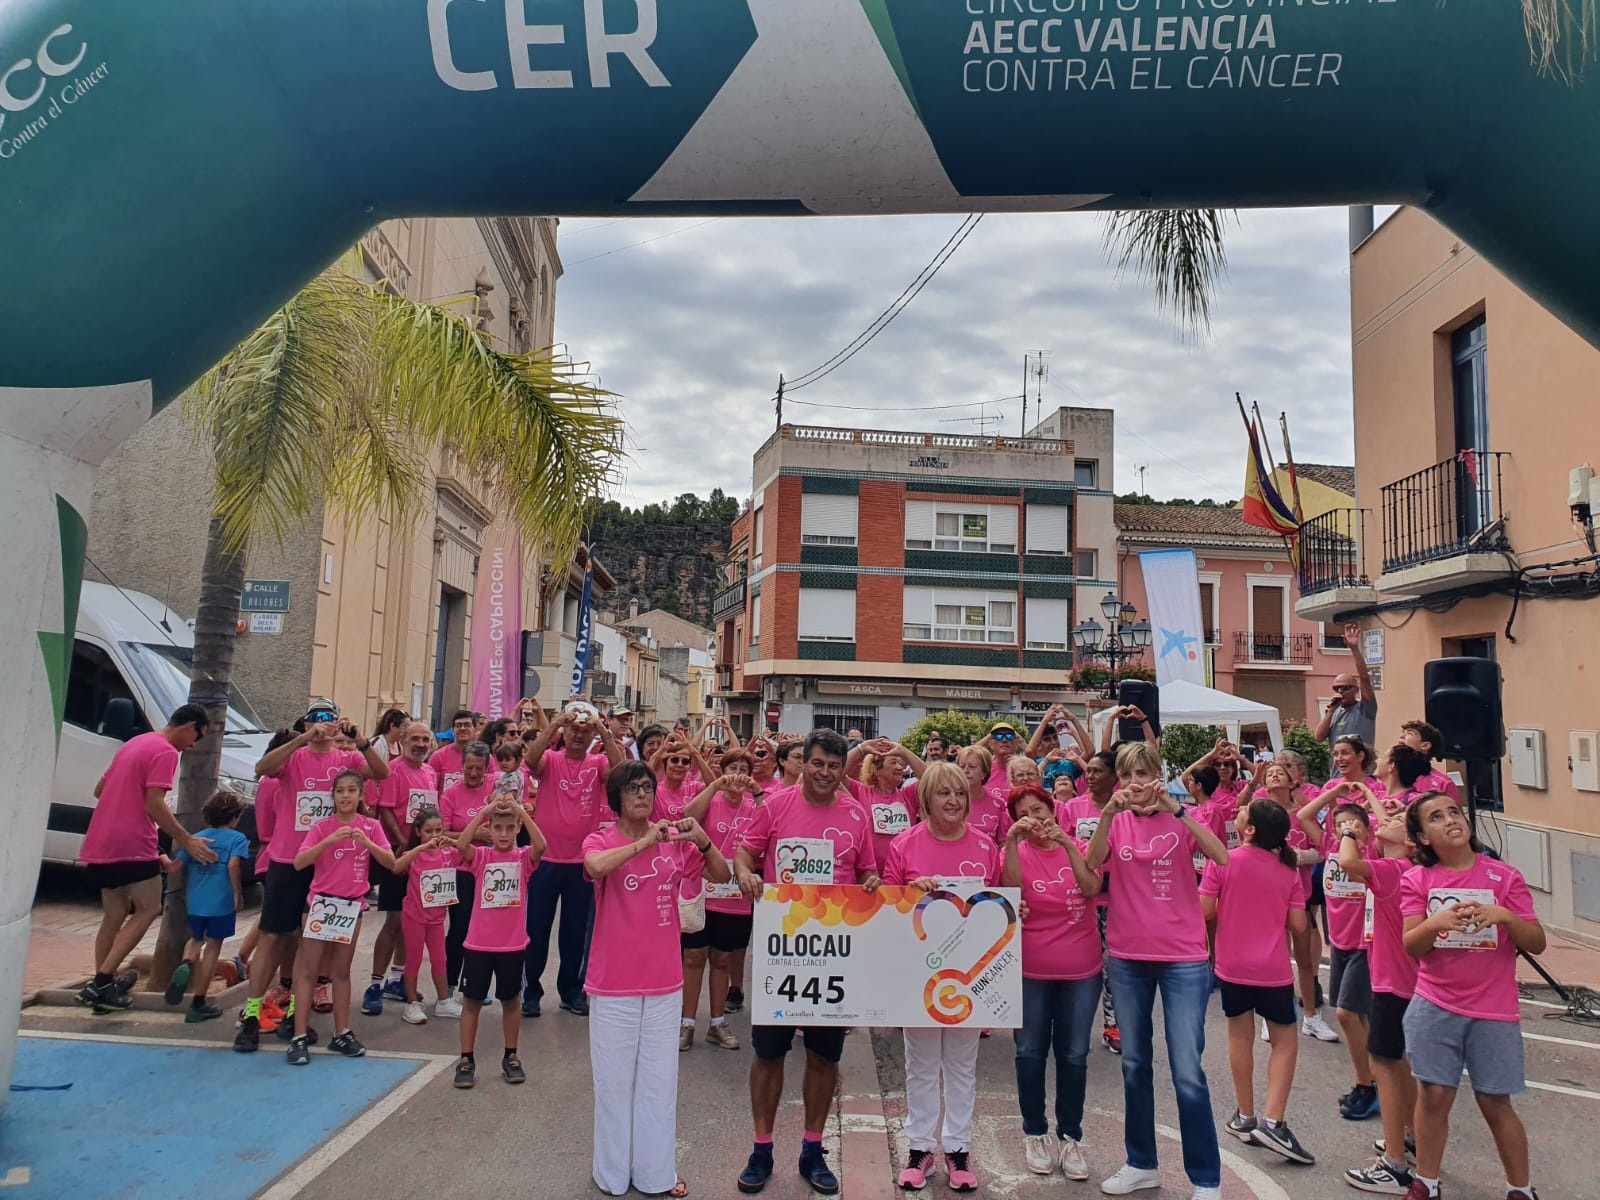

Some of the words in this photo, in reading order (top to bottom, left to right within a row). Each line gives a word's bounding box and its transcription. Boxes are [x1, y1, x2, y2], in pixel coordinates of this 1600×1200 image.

[963, 18, 1063, 55] AECC
[1073, 13, 1277, 53] VALENCIA
[426, 0, 672, 92] CER
[962, 58, 1116, 93] CONTRA
[1130, 56, 1173, 90] EL
[1186, 49, 1343, 89] CÁNCER
[0, 115, 48, 158] Contra
[48, 97, 62, 119] el
[61, 61, 109, 104] Cáncer
[253, 584, 280, 593] CALLE
[850, 685, 881, 695] TASCA
[945, 689, 982, 698] MABER
[790, 858, 832, 875] 38692
[432, 881, 455, 894] 38776
[493, 879, 519, 892] 38741
[321, 912, 355, 929] 38727
[767, 933, 852, 958] OLOCAU
[767, 959, 793, 967] CONTRA
[793, 960, 802, 968] EL
[802, 958, 828, 968] CÁNCER
